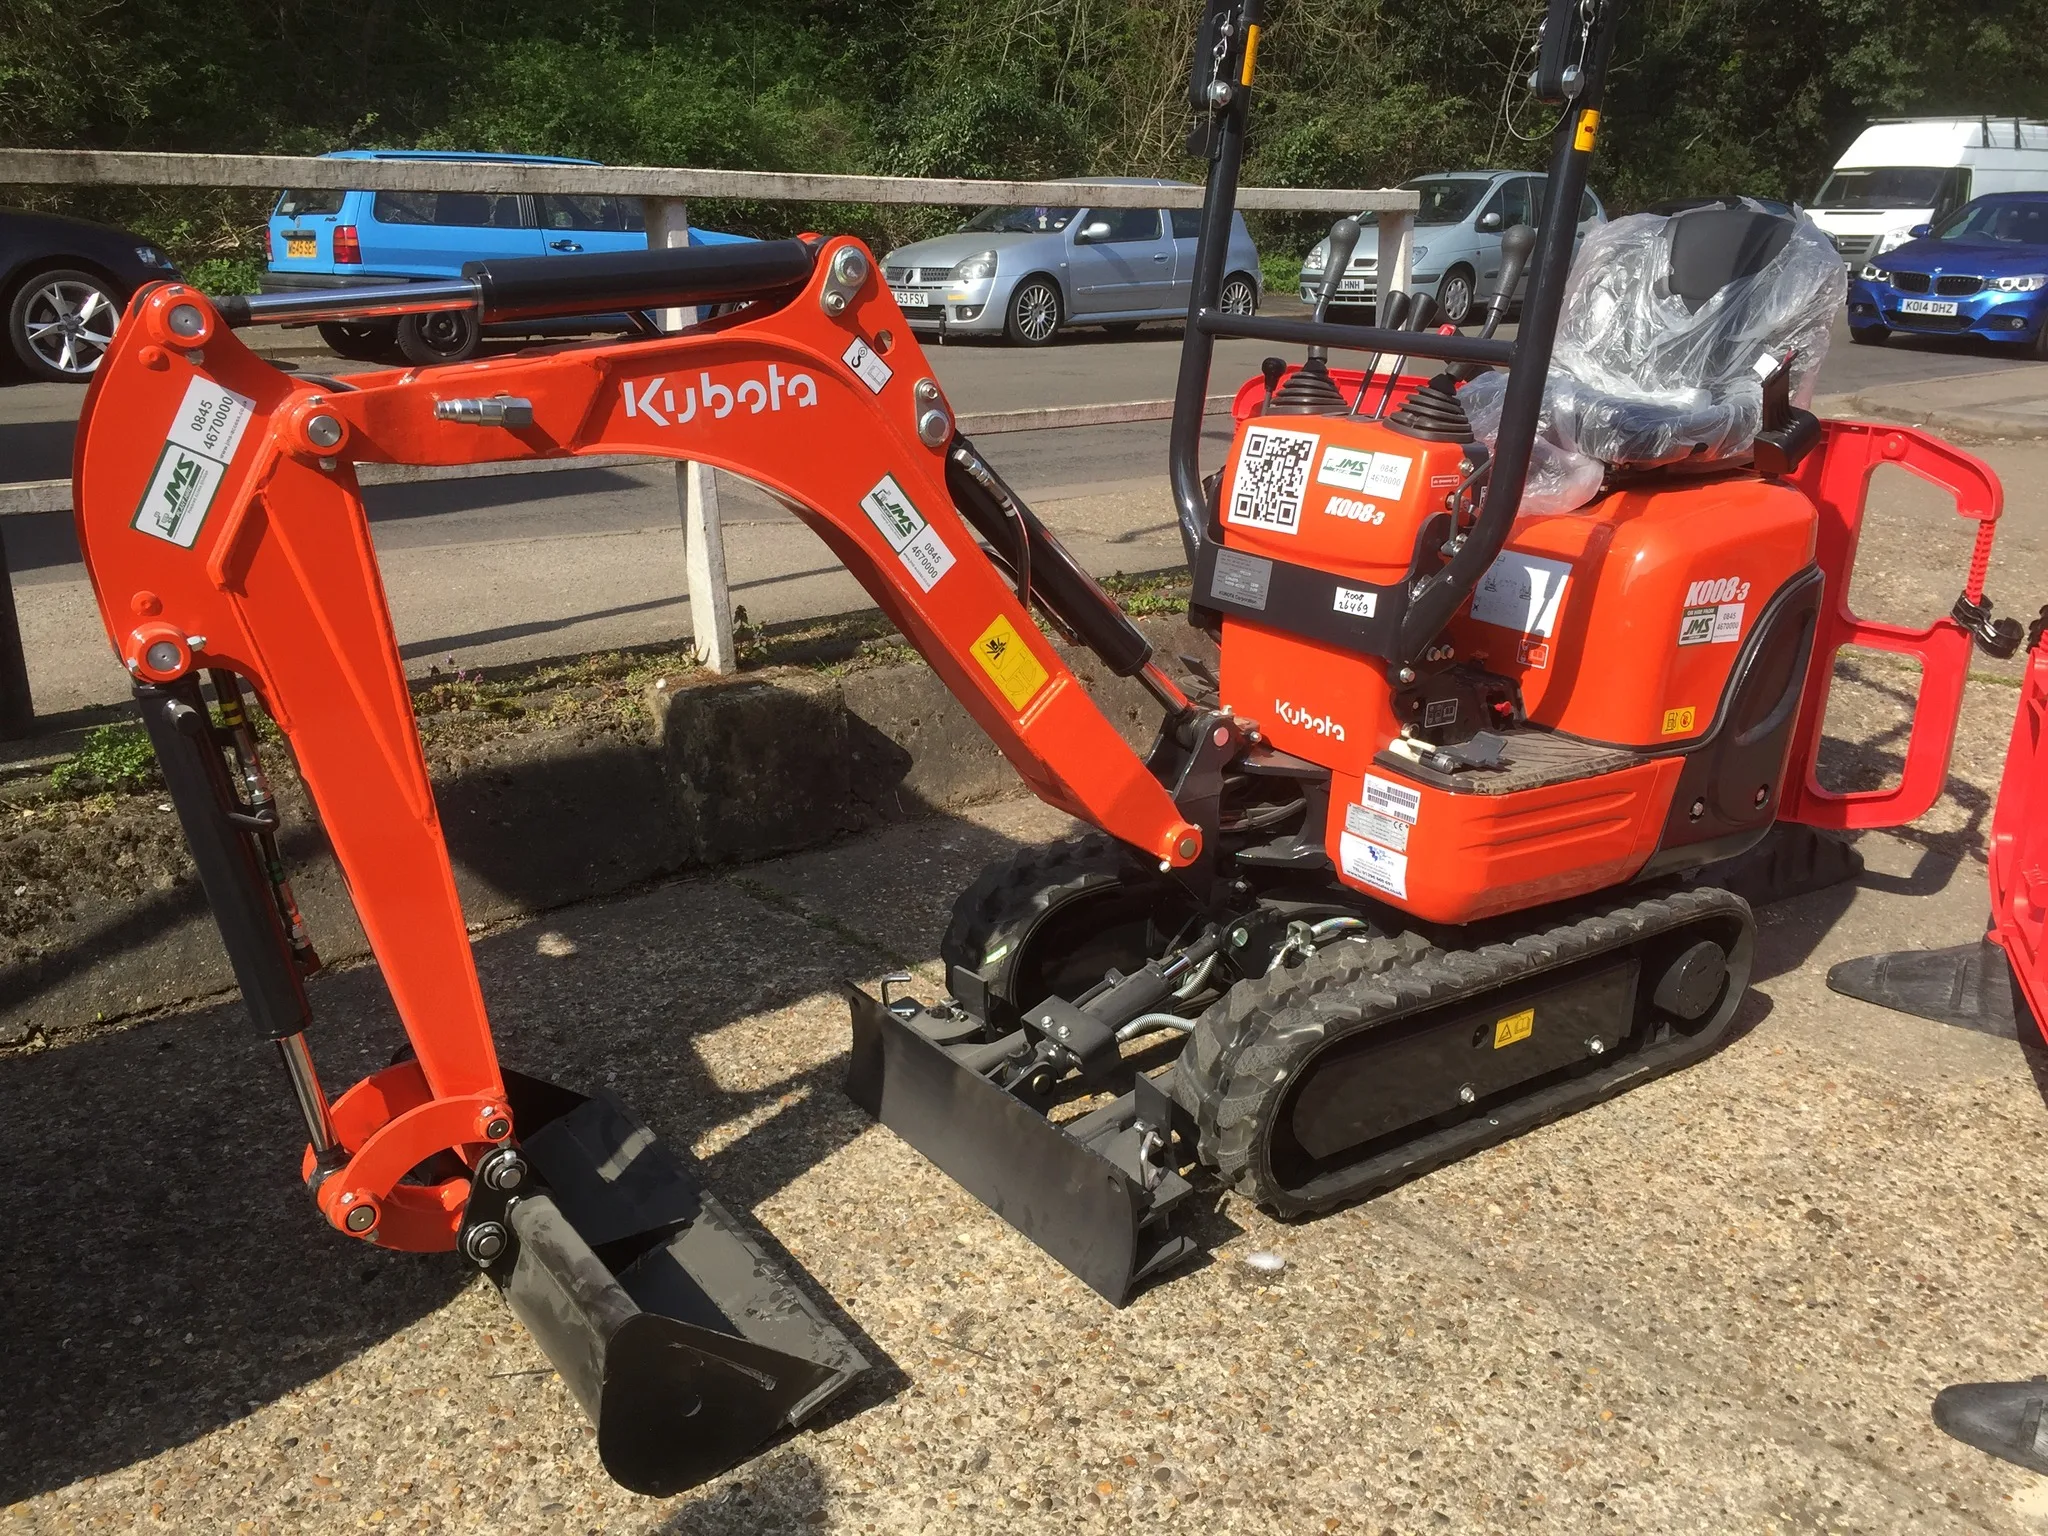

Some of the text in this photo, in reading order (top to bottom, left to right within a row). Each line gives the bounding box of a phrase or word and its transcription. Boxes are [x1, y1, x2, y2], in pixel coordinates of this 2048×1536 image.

[910, 293, 925, 305] FSX
[1344, 281, 1360, 289] HNH
[1931, 303, 1953, 314] DHZ
[623, 364, 818, 427] Kubota
[191, 400, 212, 431] 0845
[203, 396, 233, 449] 4670000
[1335, 458, 1368, 472] JMS
[1380, 464, 1398, 474] 0845
[163, 452, 195, 514] JMS
[1370, 474, 1401, 487] 4670000
[886, 502, 917, 535] JMS
[1324, 496, 1385, 525] K008-3
[912, 546, 938, 578] 4670000
[924, 543, 941, 564] 0845
[1684, 576, 1751, 607] K008-3
[1683, 618, 1713, 635] JMS
[1275, 699, 1345, 741] Kubota
